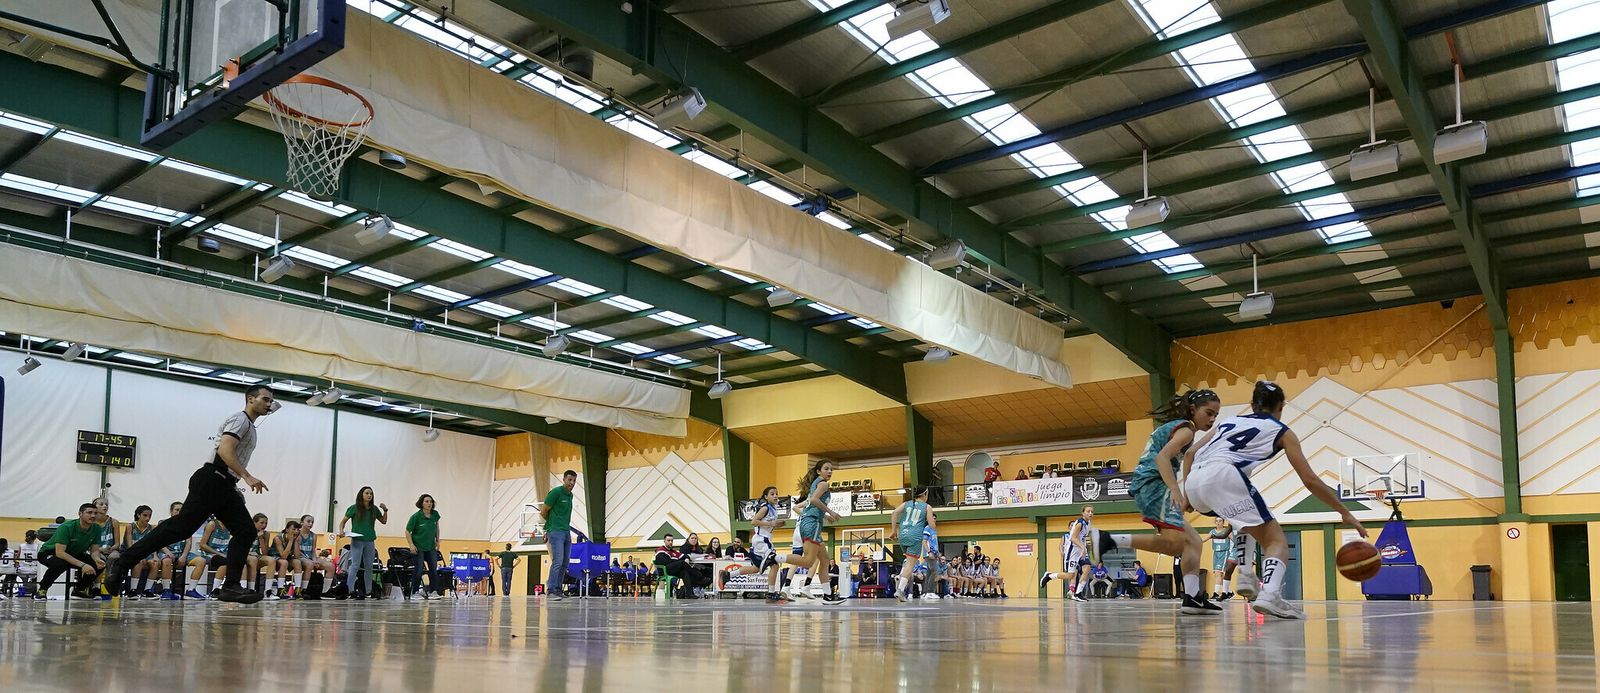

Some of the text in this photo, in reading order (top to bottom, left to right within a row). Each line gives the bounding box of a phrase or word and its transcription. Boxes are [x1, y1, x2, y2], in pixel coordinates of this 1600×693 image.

[79, 432, 85, 440] L
[129, 437, 135, 445] V
[1036, 481, 1063, 493] juega
[1039, 489, 1071, 502] limpio
[902, 506, 922, 526] 14
[24, 553, 33, 563] 15
